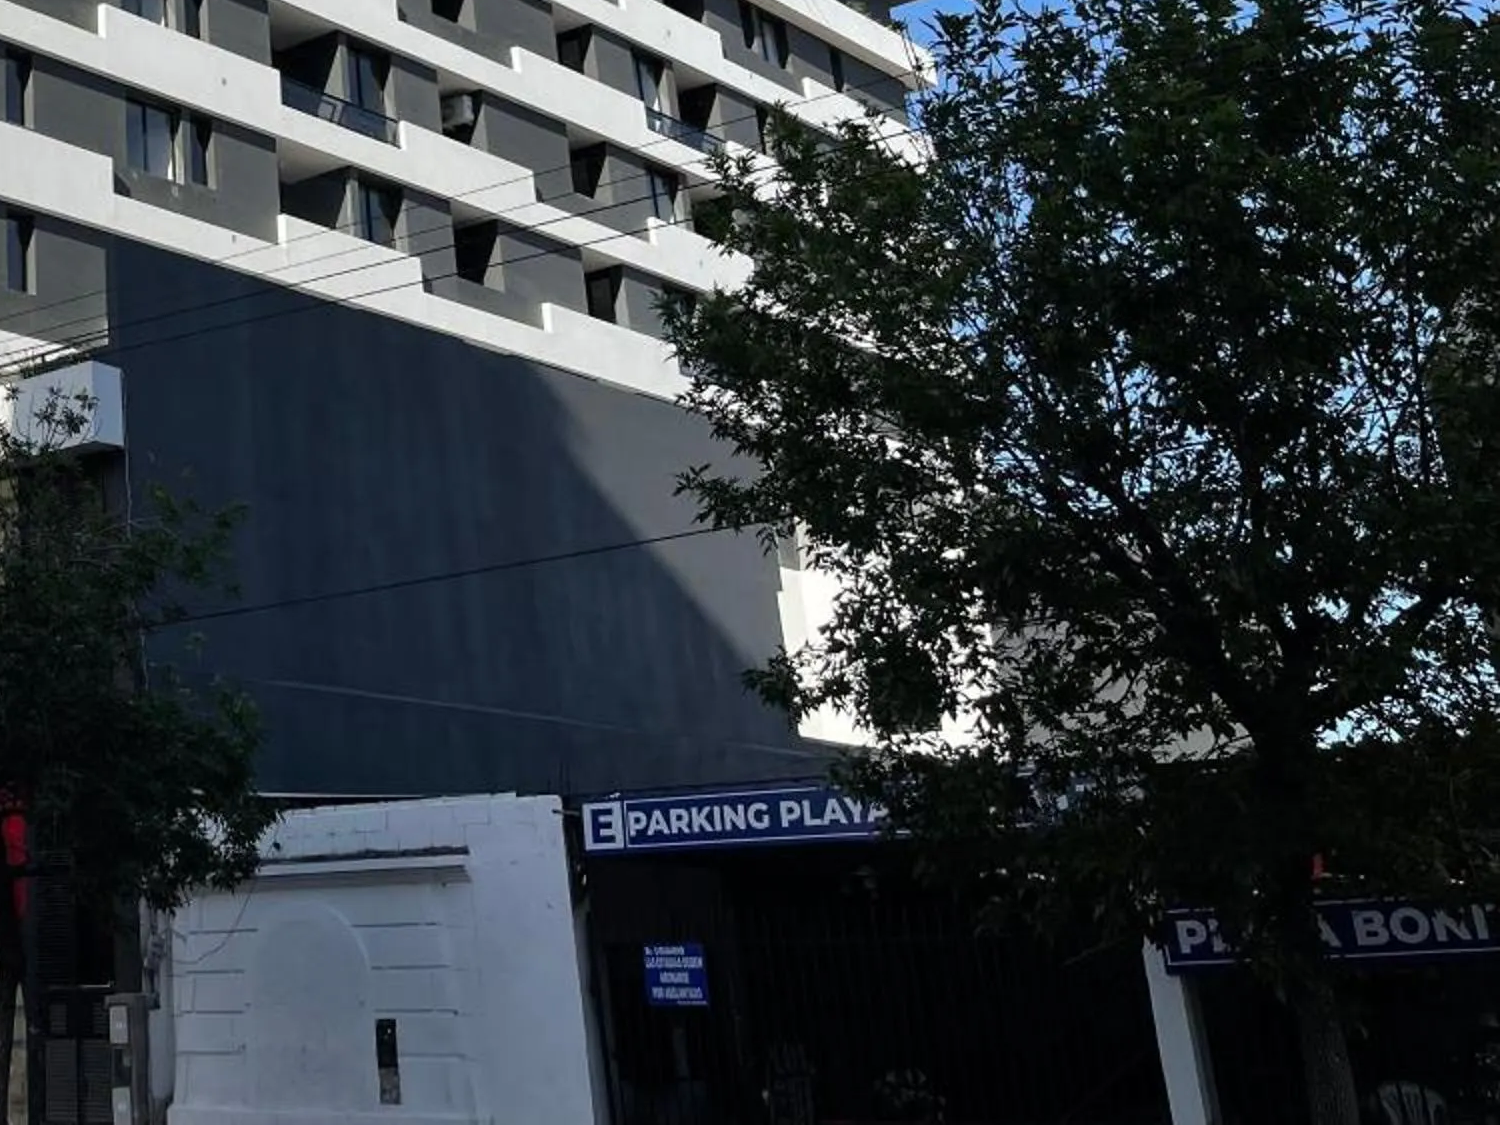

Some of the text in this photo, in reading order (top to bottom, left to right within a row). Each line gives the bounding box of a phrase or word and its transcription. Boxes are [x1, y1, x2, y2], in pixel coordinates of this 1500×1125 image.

[590, 805, 615, 843] E
[629, 803, 769, 837] PARKING
[1351, 903, 1500, 947] BONI
